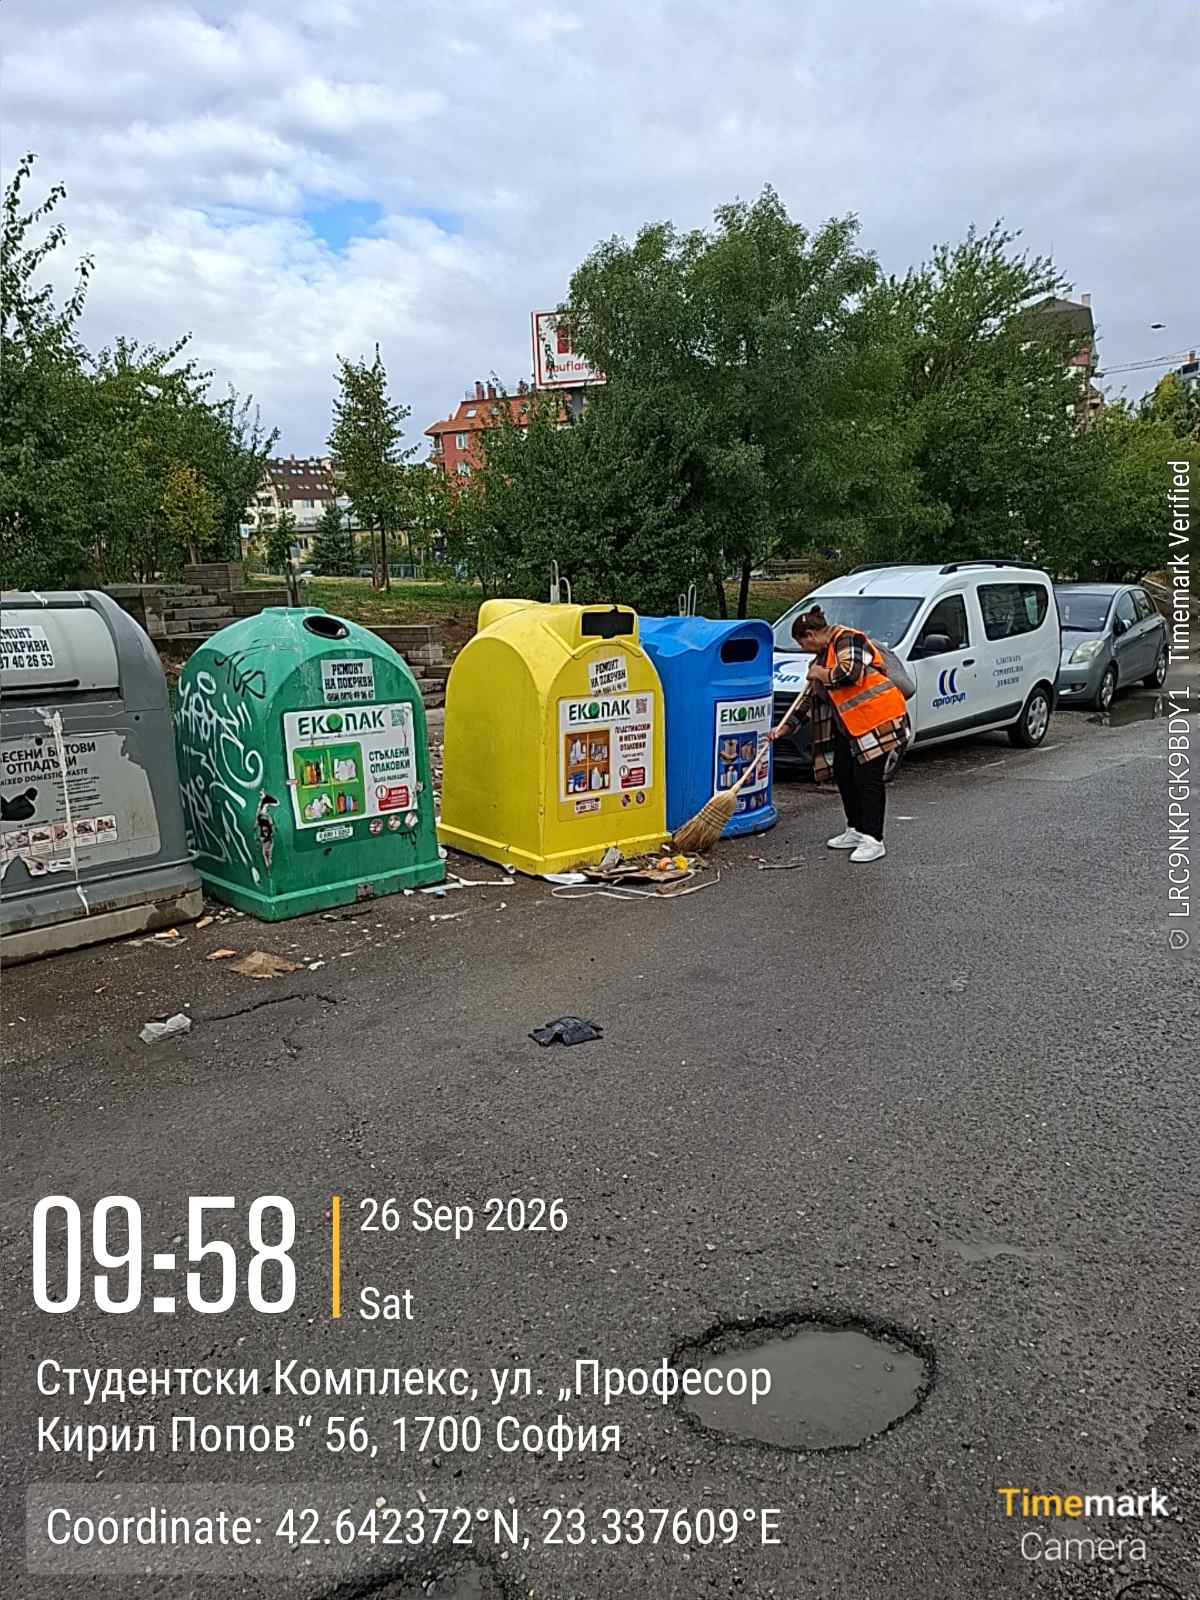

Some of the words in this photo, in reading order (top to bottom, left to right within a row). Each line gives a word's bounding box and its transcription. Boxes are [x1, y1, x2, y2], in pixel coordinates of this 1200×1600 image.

[0, 628, 32, 639] МОНТ
[12, 655, 25, 668] 40
[26, 654, 39, 667] 26
[40, 653, 54, 666] 53
[324, 678, 336, 689] НА
[298, 710, 385, 736] ЕКОПАК
[0, 748, 43, 763] ЕСЕНИ
[370, 759, 411, 774] ОПАКОВКИ
[25, 773, 63, 783] DOMESTIC
